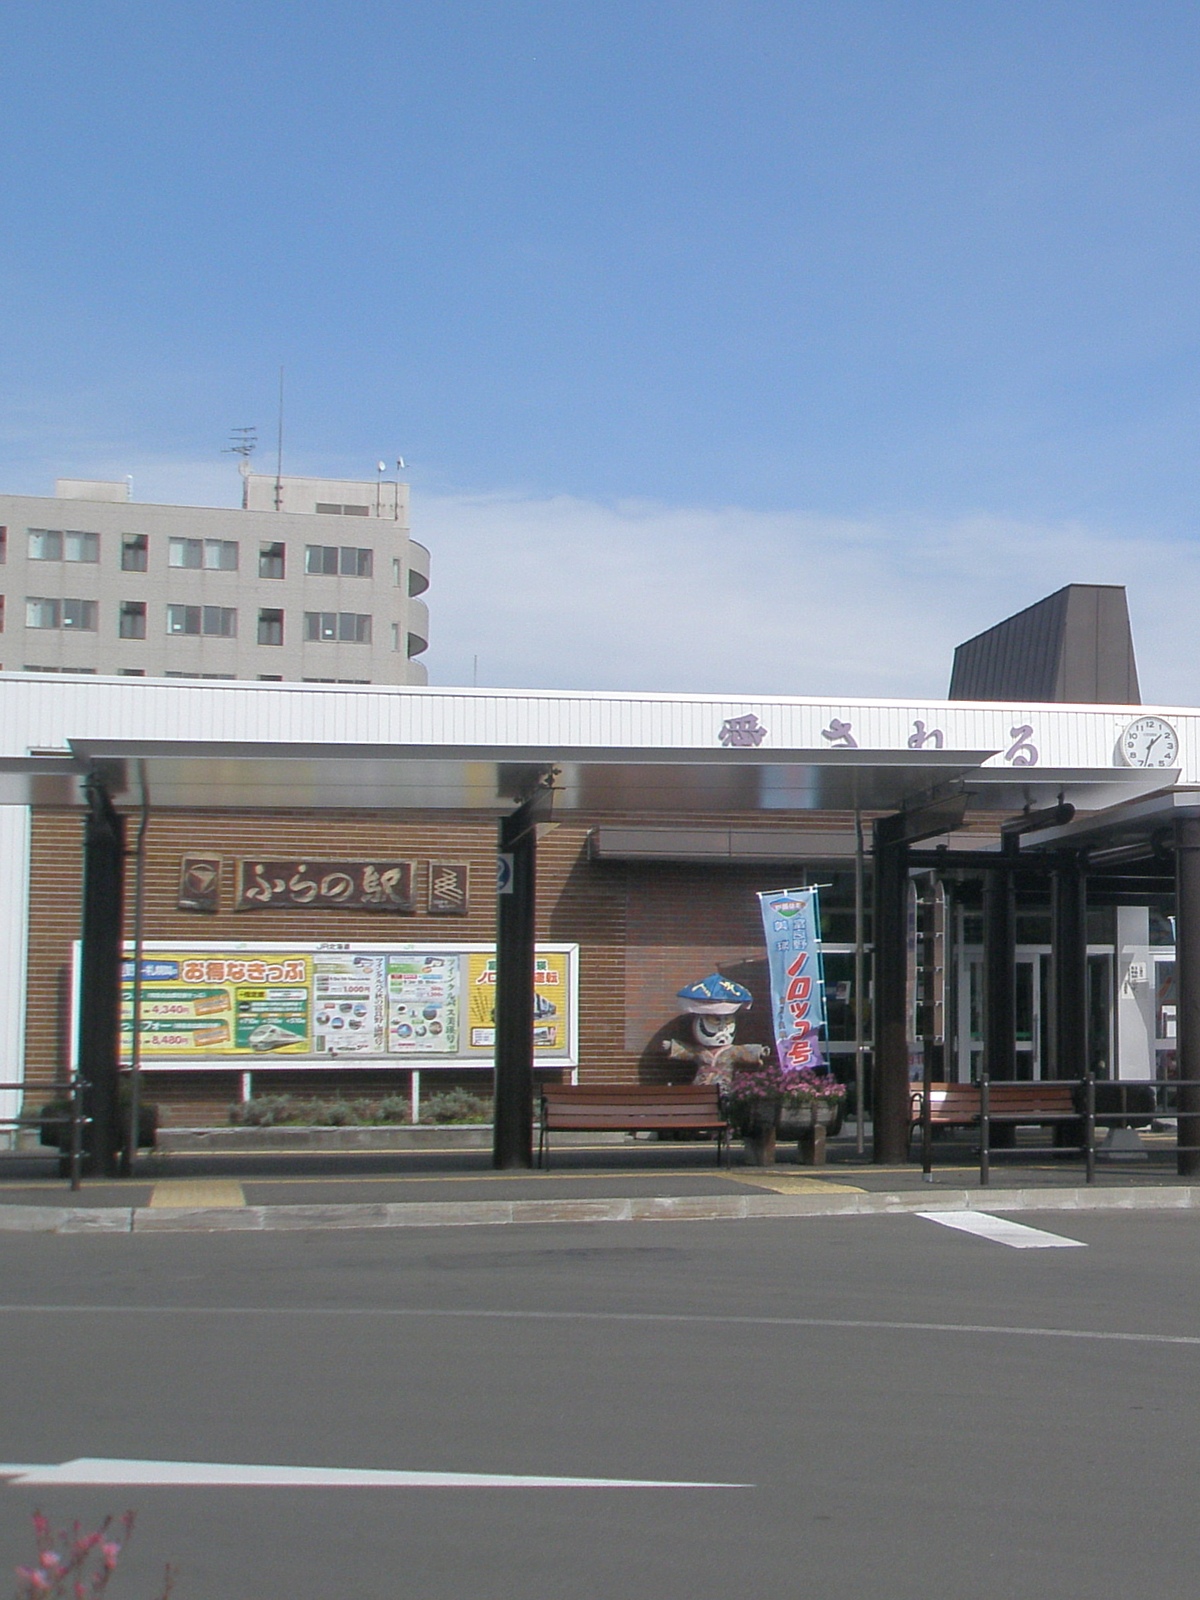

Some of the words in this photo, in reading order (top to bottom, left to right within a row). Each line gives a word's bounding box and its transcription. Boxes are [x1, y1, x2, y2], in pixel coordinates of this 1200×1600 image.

[246, 864, 400, 903] ふらの駅
[183, 958, 306, 982] お得なきっぷ
[787, 952, 814, 1065] ノロッコ号
